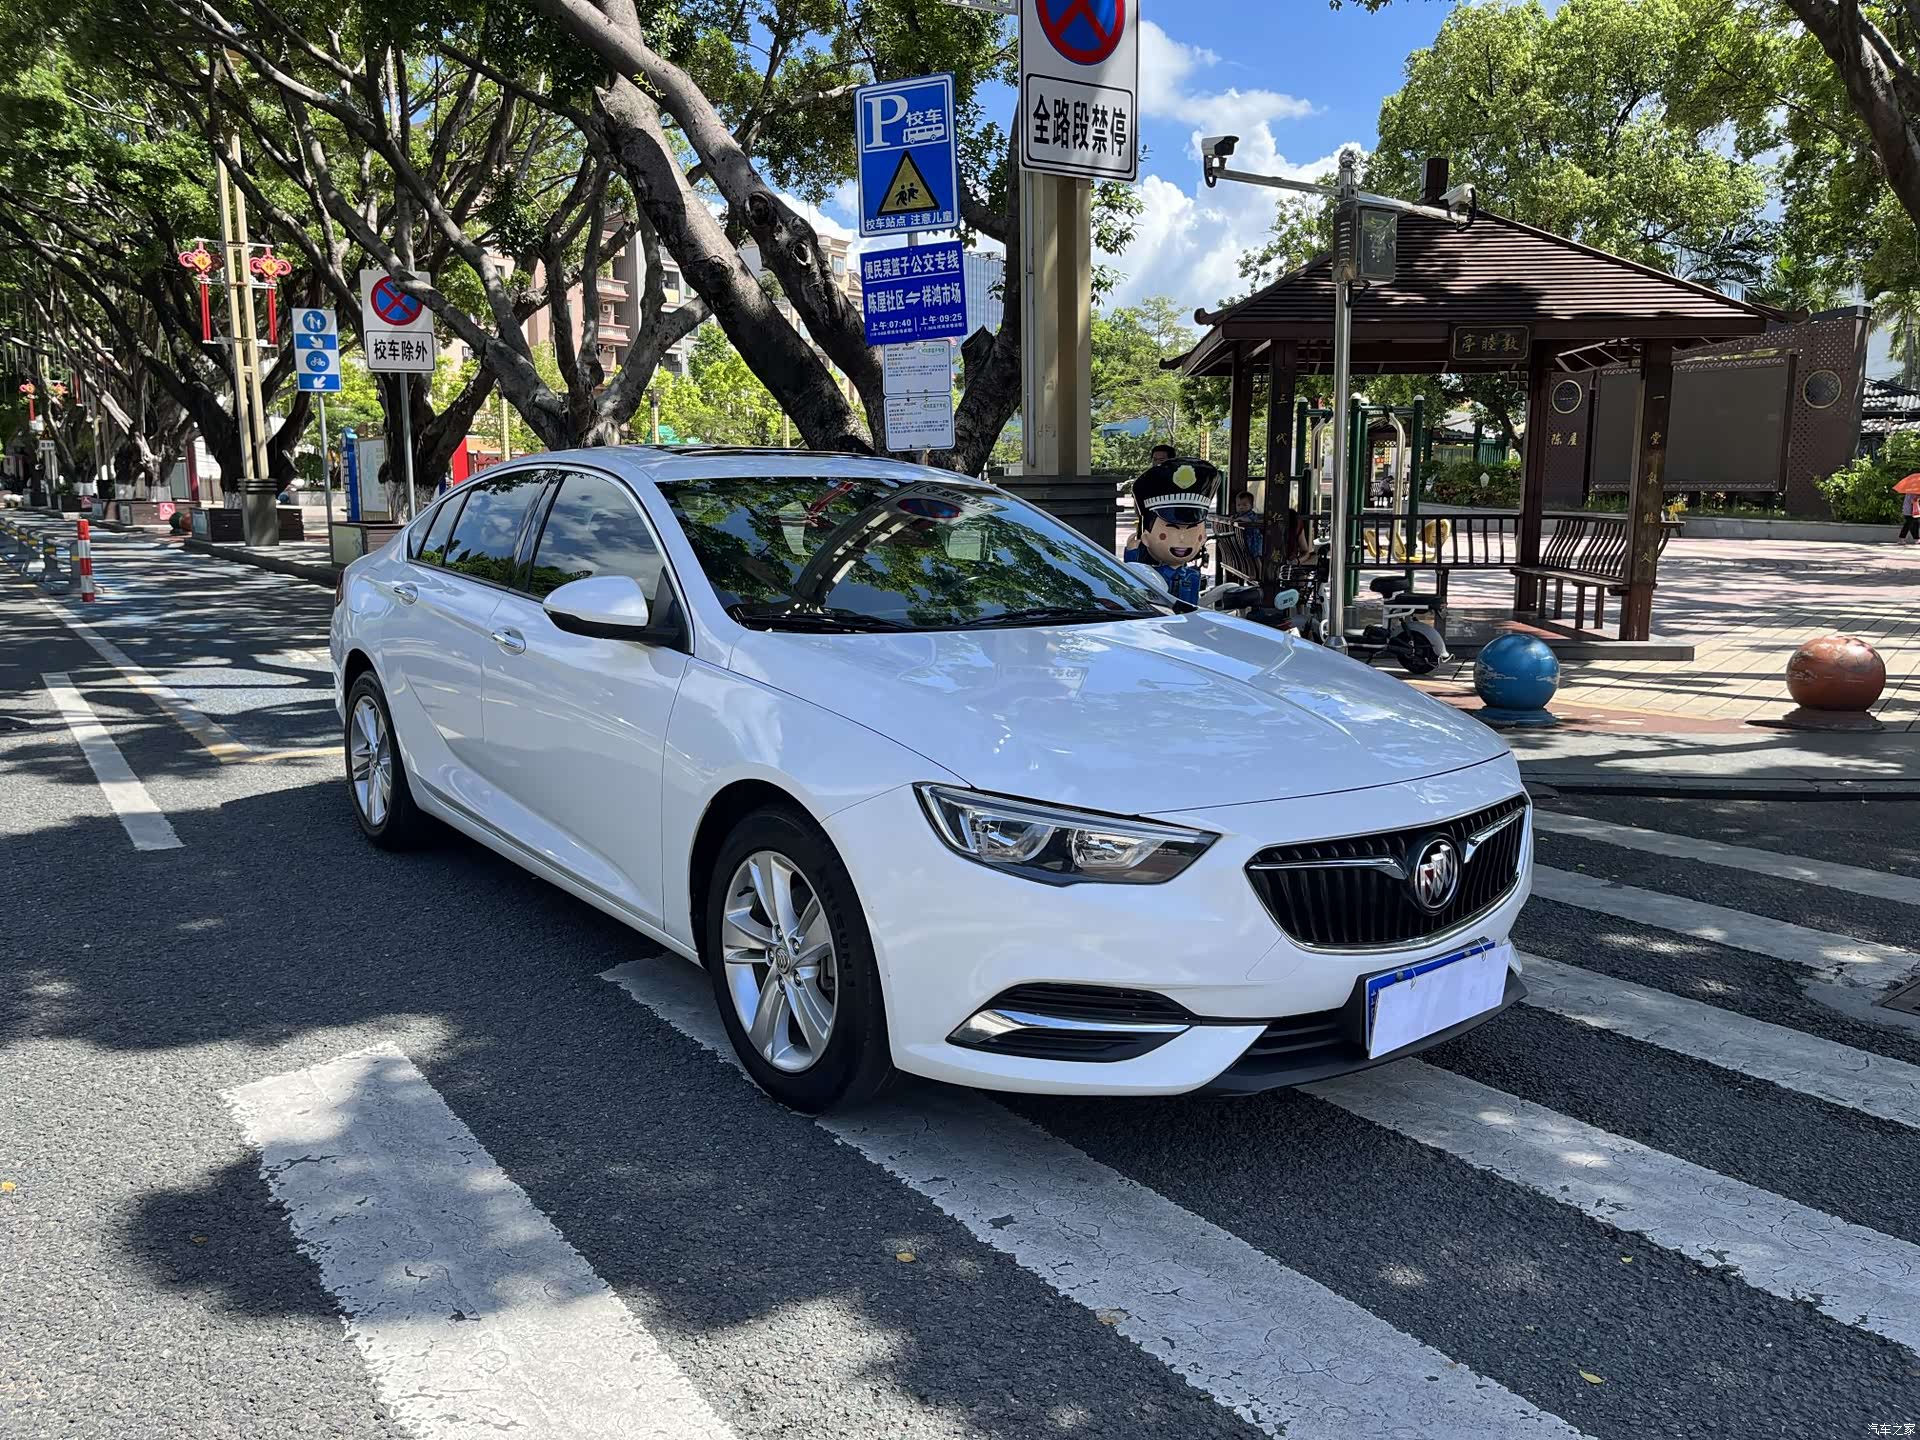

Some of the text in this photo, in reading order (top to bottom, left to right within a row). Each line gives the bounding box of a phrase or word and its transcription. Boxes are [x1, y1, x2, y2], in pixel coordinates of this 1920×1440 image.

[865, 94, 908, 149] P
[905, 108, 943, 127] 校车
[1032, 95, 1127, 157] 全路段禁停
[865, 210, 953, 231] 校车站点 注意儿童
[864, 249, 960, 280] 便民菜篮子公交专线
[867, 289, 906, 315] 陈屋社区
[373, 338, 428, 362] 校车除外
[1551, 432, 1577, 446] 陈屋
